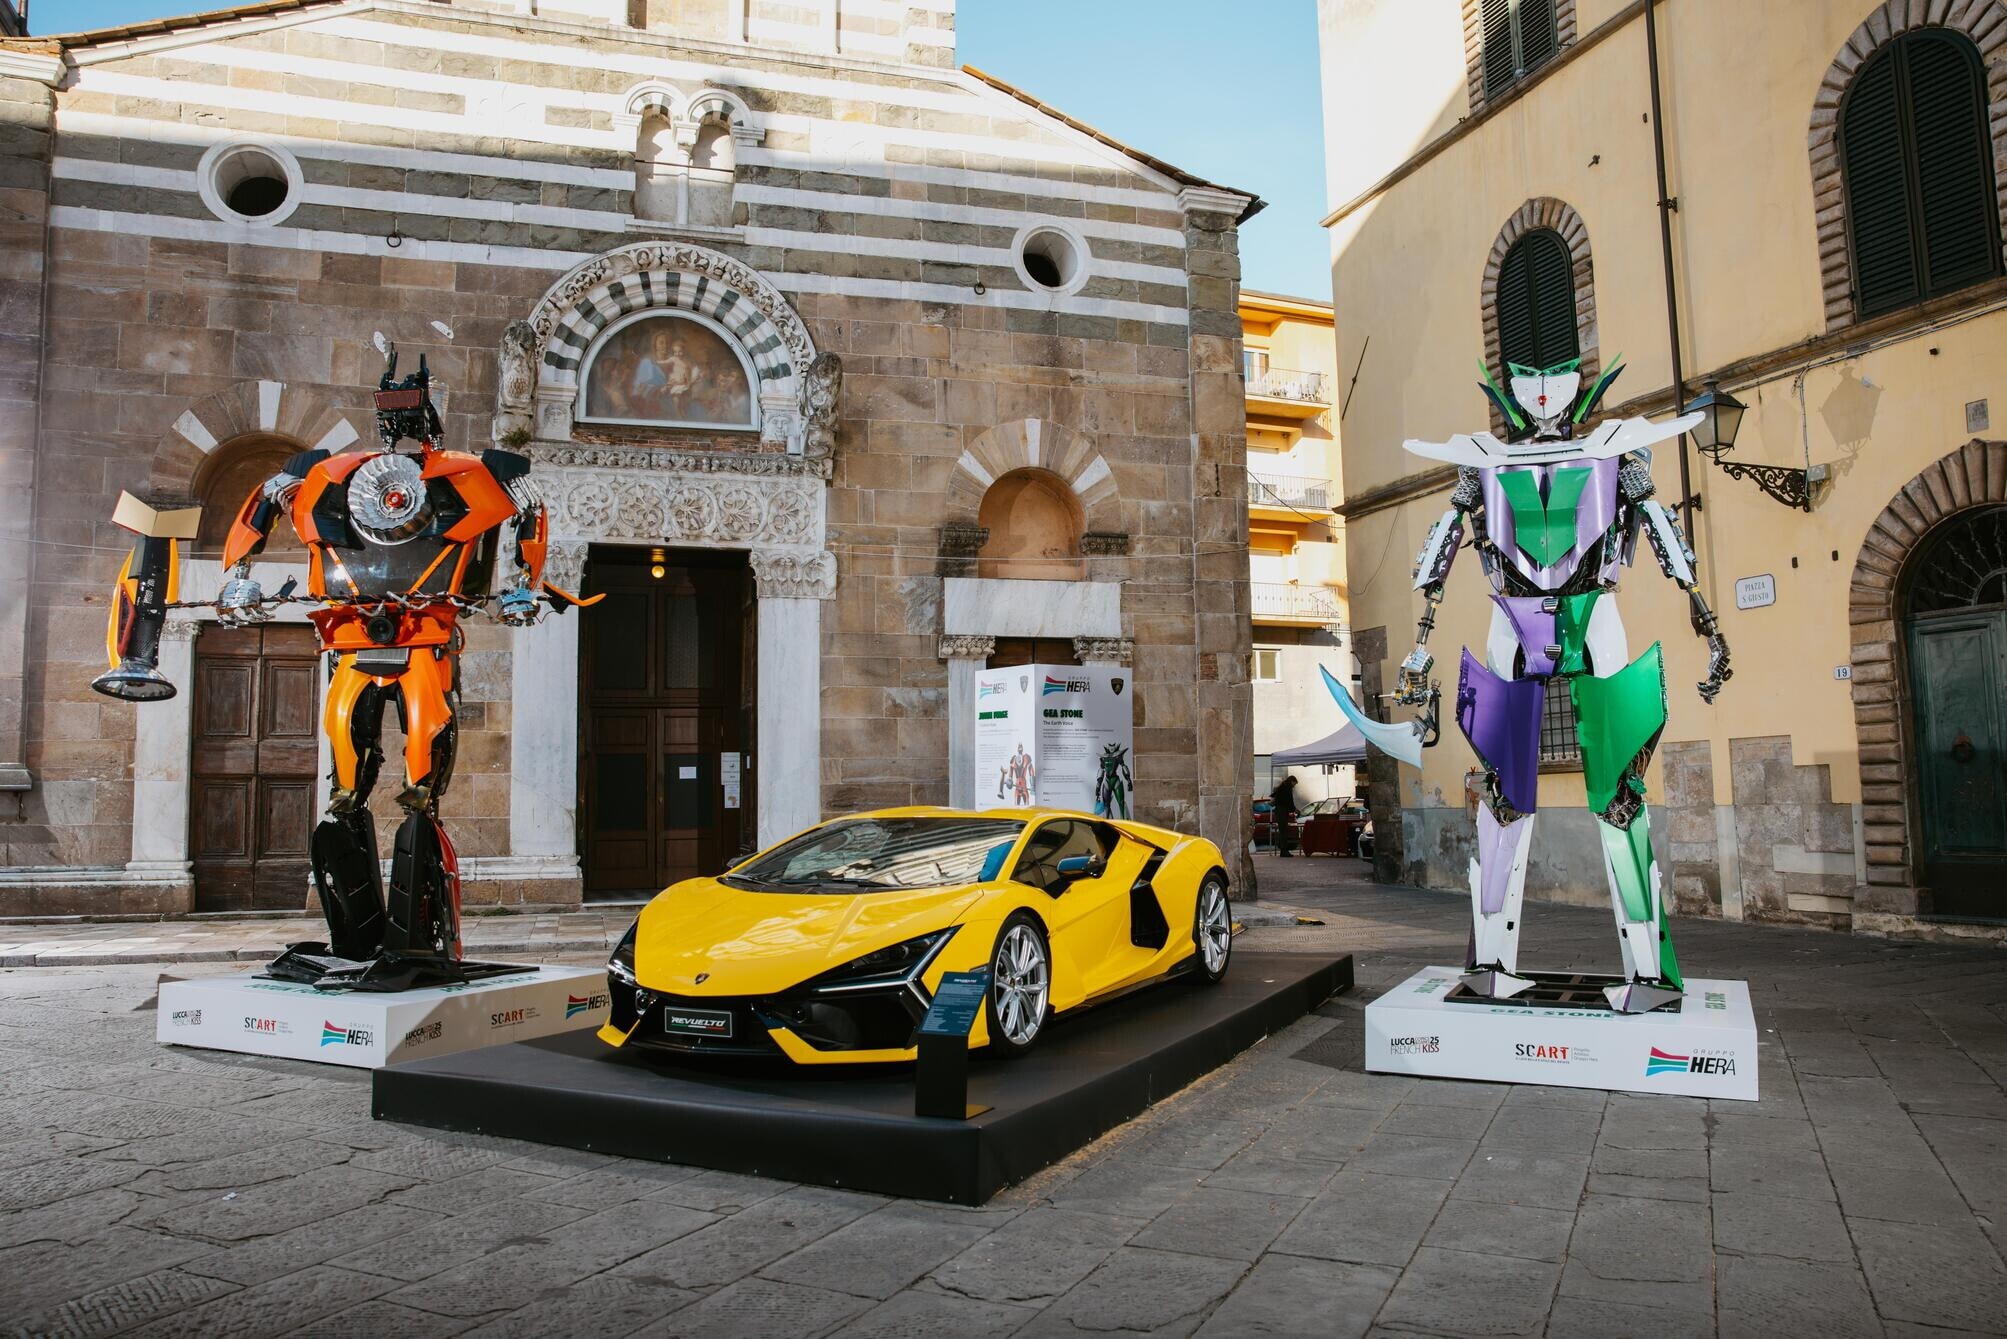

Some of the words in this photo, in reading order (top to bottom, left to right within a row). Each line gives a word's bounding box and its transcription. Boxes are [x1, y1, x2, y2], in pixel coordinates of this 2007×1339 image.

[1745, 582, 1766, 593] PIAZZA
[1749, 593, 1769, 602] GIUSTO
[1837, 668, 1848, 678] 19
[1066, 681, 1091, 693] HERA
[1043, 708, 1059, 718] GEA
[1060, 709, 1083, 718] STONE
[587, 994, 610, 1010] HERA
[172, 1010, 187, 1019] LUCCA
[195, 1009, 202, 1017] 25
[491, 1009, 525, 1026] SCART
[1543, 1010, 1616, 1018] STONE
[244, 1016, 277, 1032] SCART
[671, 1016, 726, 1027] REVUELTO
[405, 1026, 425, 1040] LUCCA
[434, 1021, 442, 1031] 25
[346, 1029, 374, 1047] HERA
[1390, 1037, 1415, 1046] LUCCA
[1430, 1036, 1440, 1044] 25
[1390, 1045, 1421, 1055] FRENCH
[1422, 1043, 1440, 1054] KISS
[1515, 1043, 1569, 1060] SCART
[1693, 1048, 1735, 1057] GRUPPO
[1690, 1056, 1736, 1076] HERA
